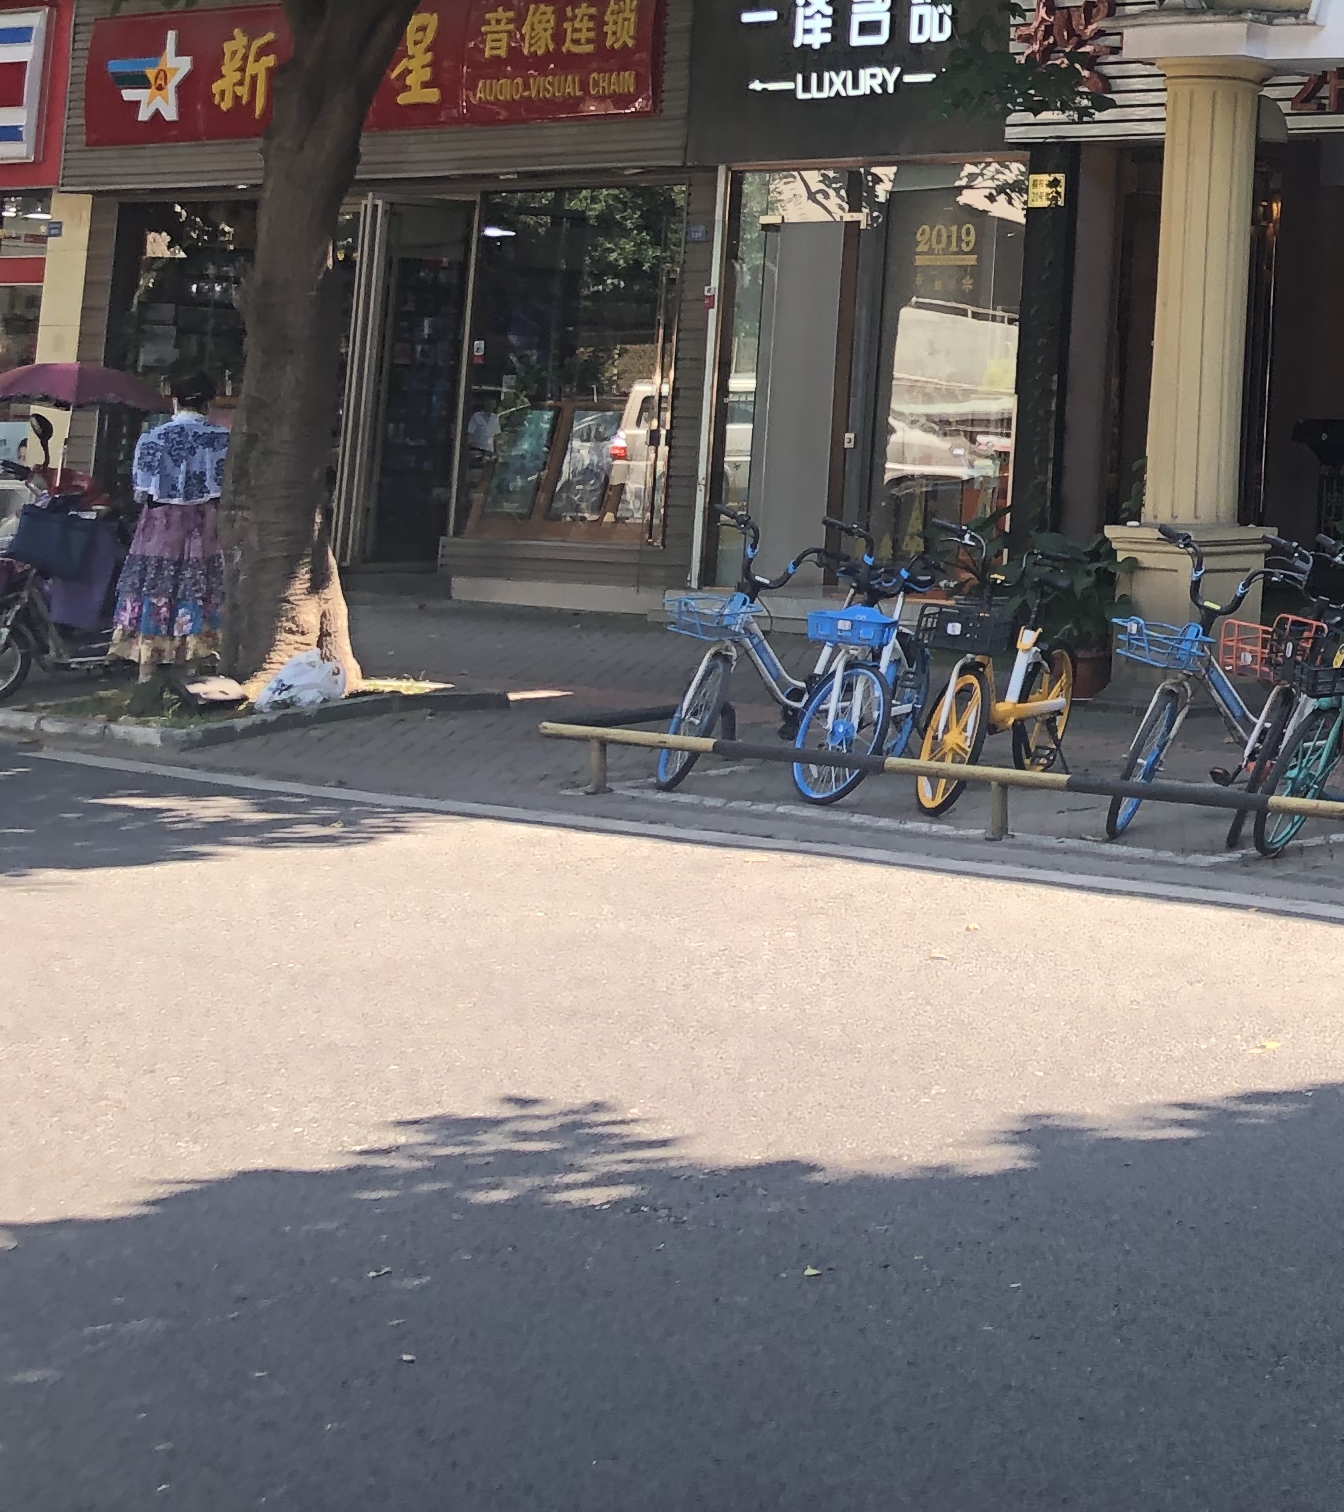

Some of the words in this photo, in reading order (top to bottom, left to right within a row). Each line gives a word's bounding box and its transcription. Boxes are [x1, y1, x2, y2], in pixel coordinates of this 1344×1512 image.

[211, 12, 443, 119] 新星
[475, 75, 582, 103] AUDIO-VISUAL
[589, 70, 637, 97] CHAIN
[796, 67, 901, 100] LUXURY
[915, 223, 976, 254] 2019
